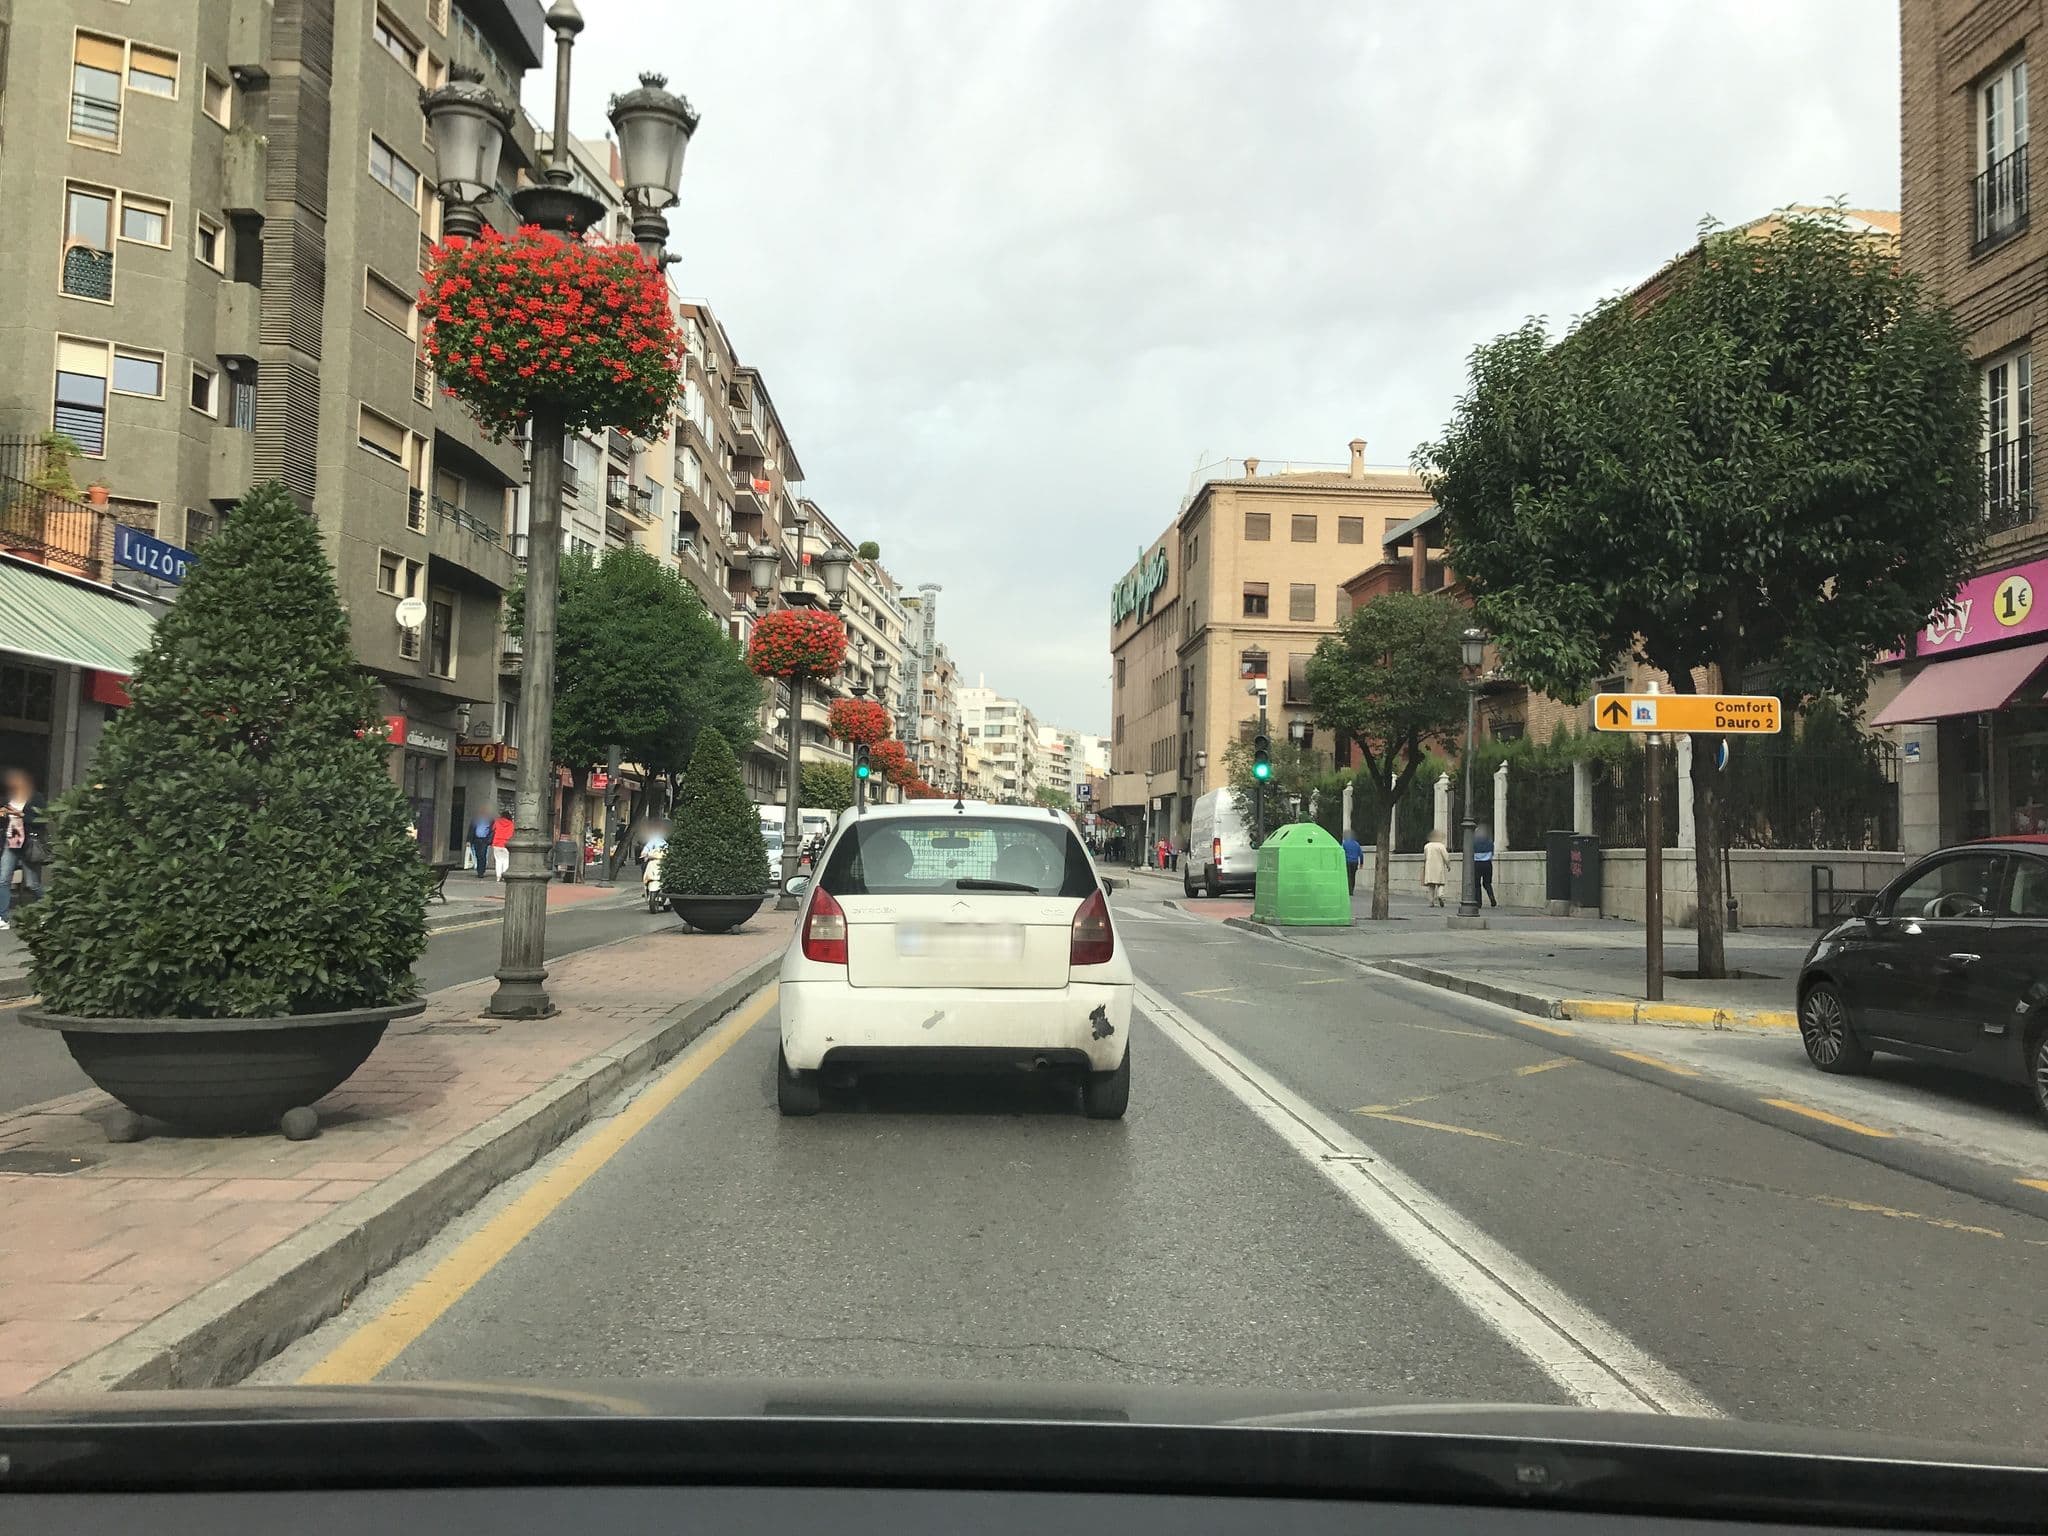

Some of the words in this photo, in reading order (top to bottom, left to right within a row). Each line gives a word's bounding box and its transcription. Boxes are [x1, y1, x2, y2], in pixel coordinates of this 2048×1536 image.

[124, 532, 187, 578] Luzón
[1714, 701, 1773, 713] Comfort
[1715, 716, 1760, 729] Dauro
[1766, 718, 1774, 728] 2
